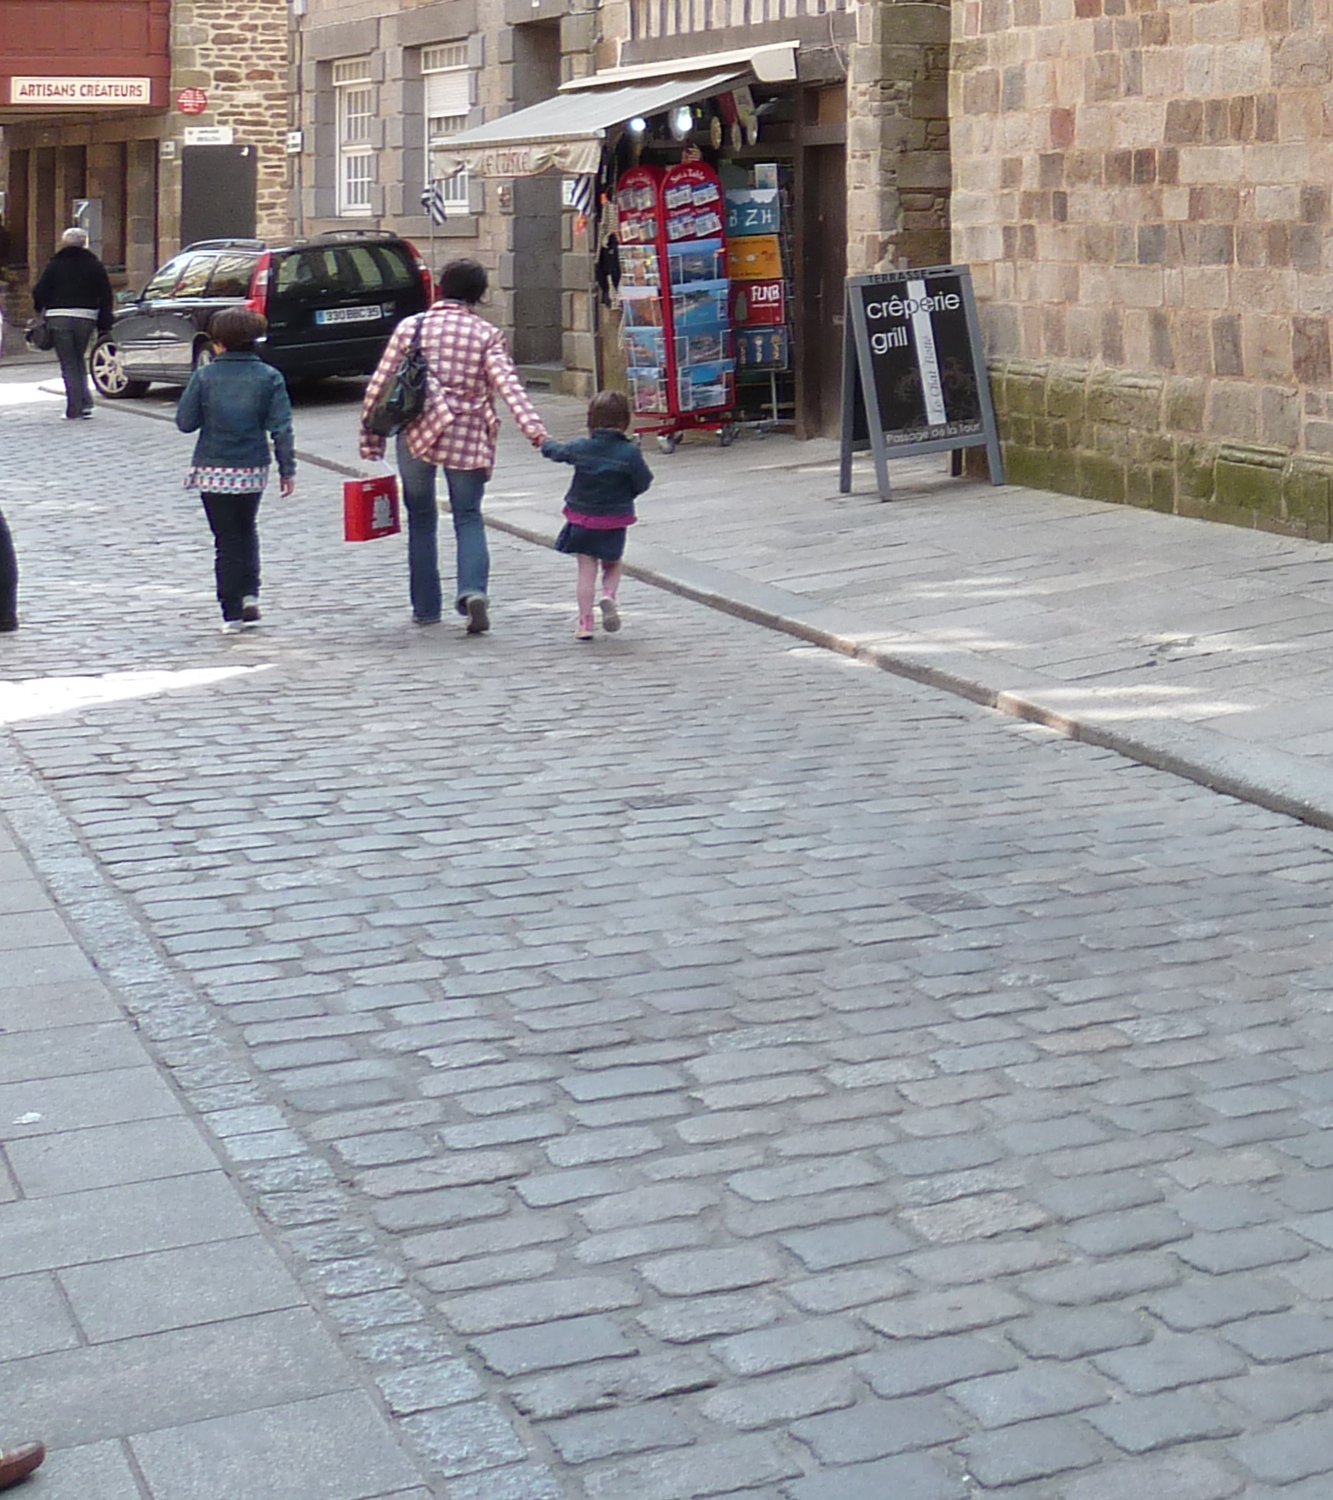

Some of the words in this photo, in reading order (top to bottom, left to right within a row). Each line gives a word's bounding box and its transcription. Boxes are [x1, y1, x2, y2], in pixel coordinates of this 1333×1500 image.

[19, 82, 76, 98] ARTISANS
[79, 80, 143, 98] CRÉATEURS
[868, 269, 929, 284] TERRASSE
[866, 291, 961, 319] crêperie
[871, 326, 908, 355] grill
[886, 430, 929, 444] Passage
[931, 427, 945, 438] de
[947, 424, 957, 435] la
[959, 423, 981, 434] Tour
